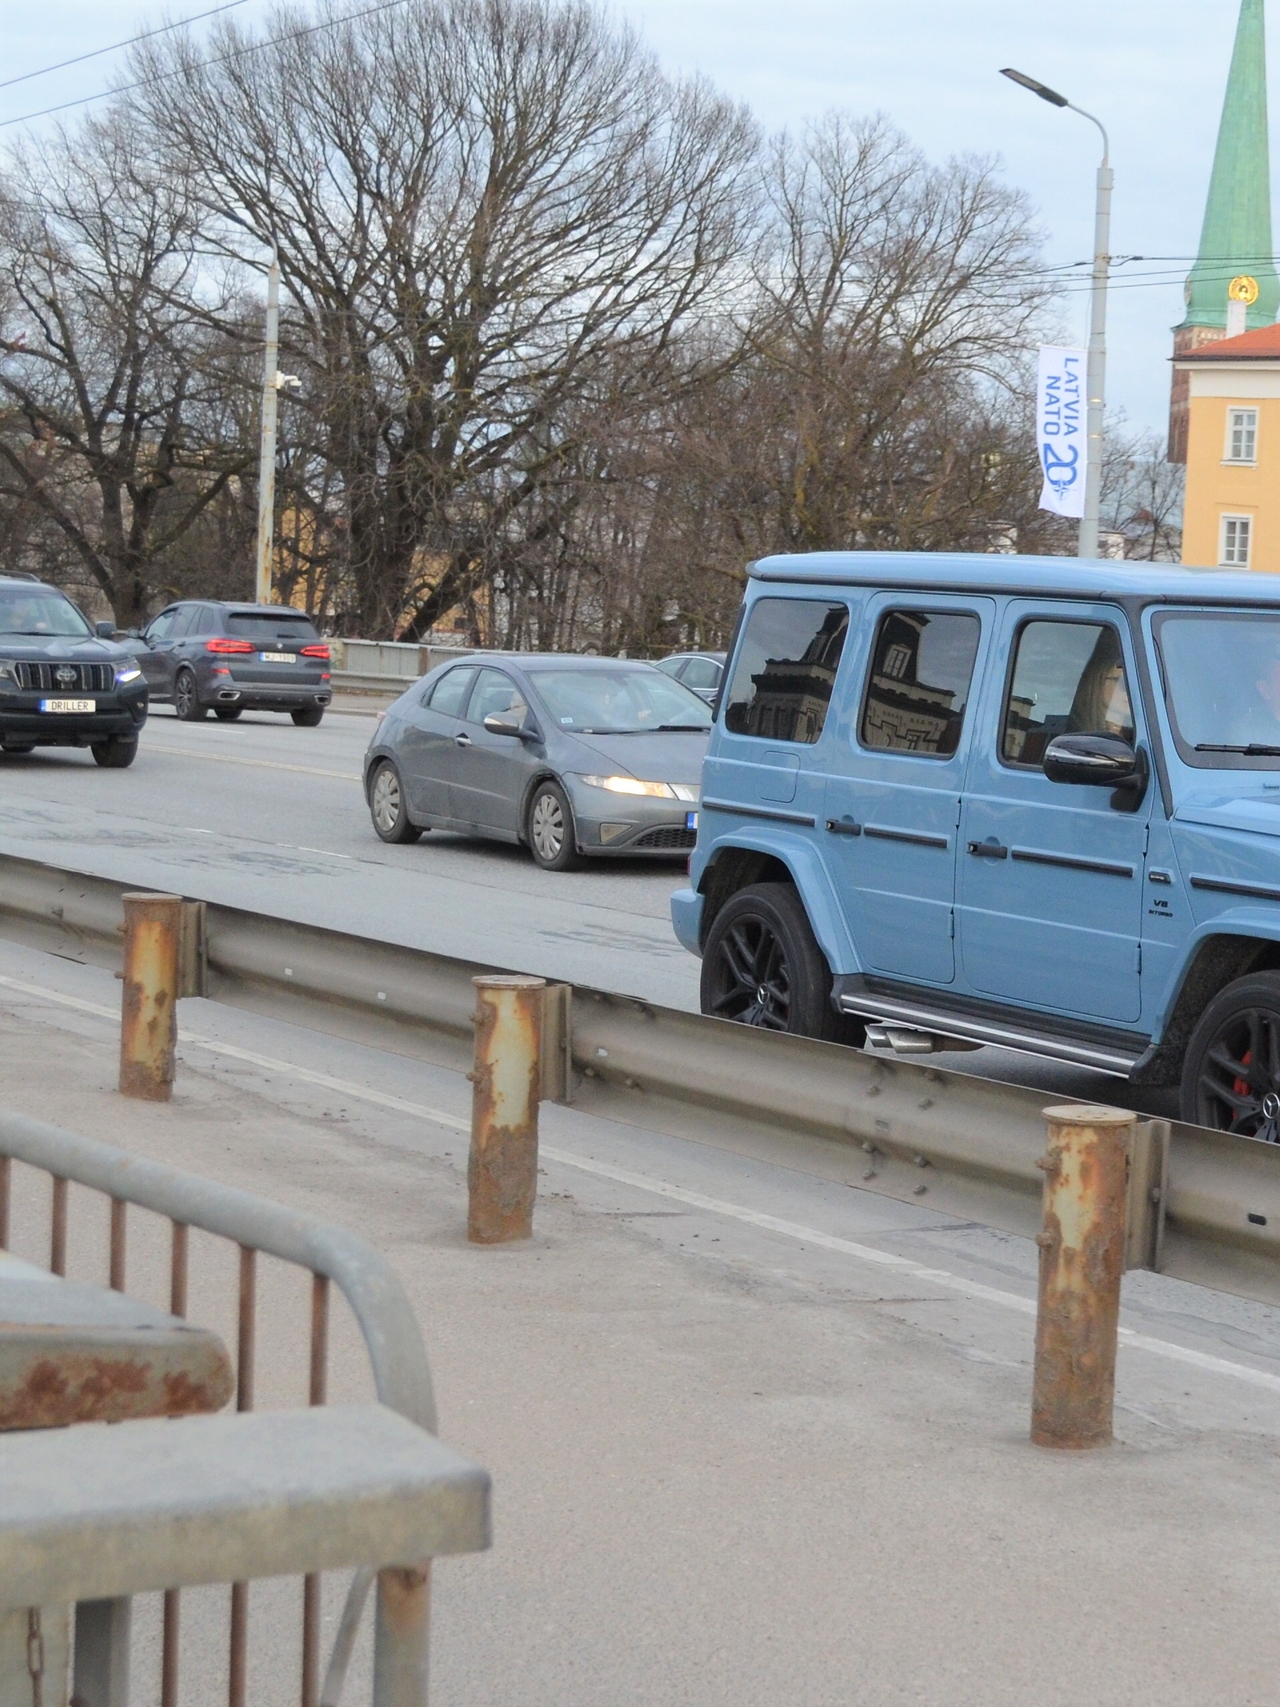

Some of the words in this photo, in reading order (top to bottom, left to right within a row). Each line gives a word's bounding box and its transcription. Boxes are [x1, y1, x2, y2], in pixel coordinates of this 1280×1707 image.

[1043, 375, 1061, 436] NATO
[1063, 357, 1080, 437] LATVIA
[51, 701, 89, 711] DRILLER
[1153, 899, 1169, 908] V8
